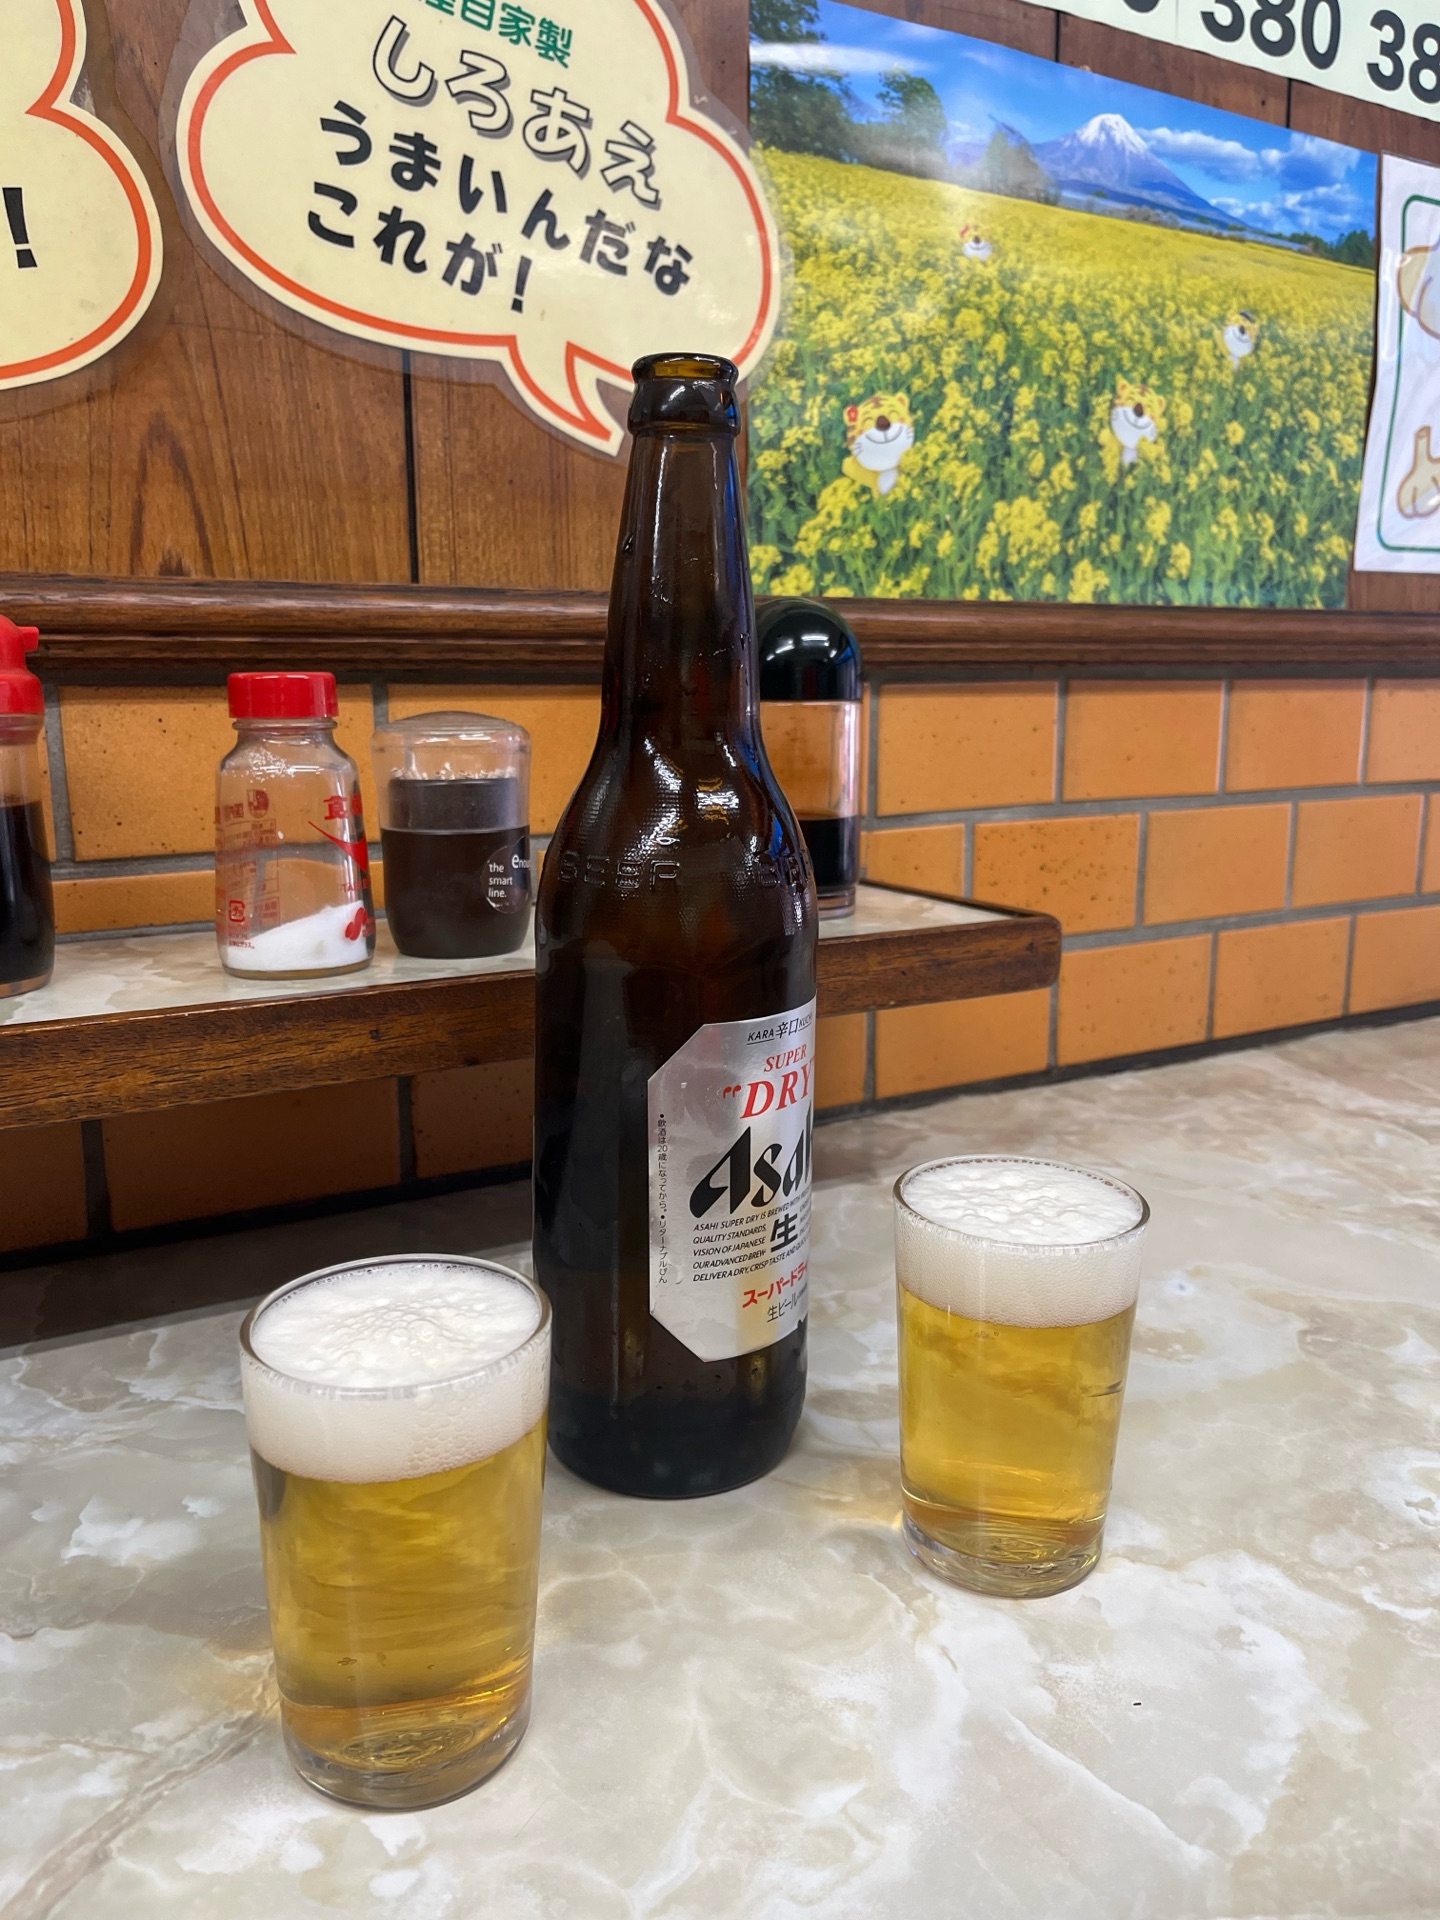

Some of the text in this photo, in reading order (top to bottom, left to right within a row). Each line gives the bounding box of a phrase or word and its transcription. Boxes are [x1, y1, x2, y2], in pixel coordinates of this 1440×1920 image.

[373, 15, 661, 209] しろあえ
[320, 102, 694, 296] うまいんだな
[306, 181, 534, 314] これが!
[489, 862, 504, 873] the
[488, 876, 513, 886] smart
[488, 887, 507, 898] line.
[747, 1028, 774, 1042] KARA
[775, 1017, 799, 1039] 辛口
[763, 1044, 807, 1073] SUPER
[693, 1222, 719, 1231] ASAHI
[720, 1217, 745, 1229] SUPER
[745, 1213, 760, 1225] DRY
[770, 1213, 798, 1253] 生
[693, 1233, 727, 1244] QUALITY
[693, 1236, 766, 1257] VISION OF JAPANESE
[692, 1260, 711, 1270] OUR
[709, 1253, 748, 1267] ADVANCED
[693, 1270, 728, 1282] DELIVER
[727, 1269, 733, 1277] A
[749, 1259, 769, 1272] CRISP
[767, 1292, 799, 1323] 生ビール
